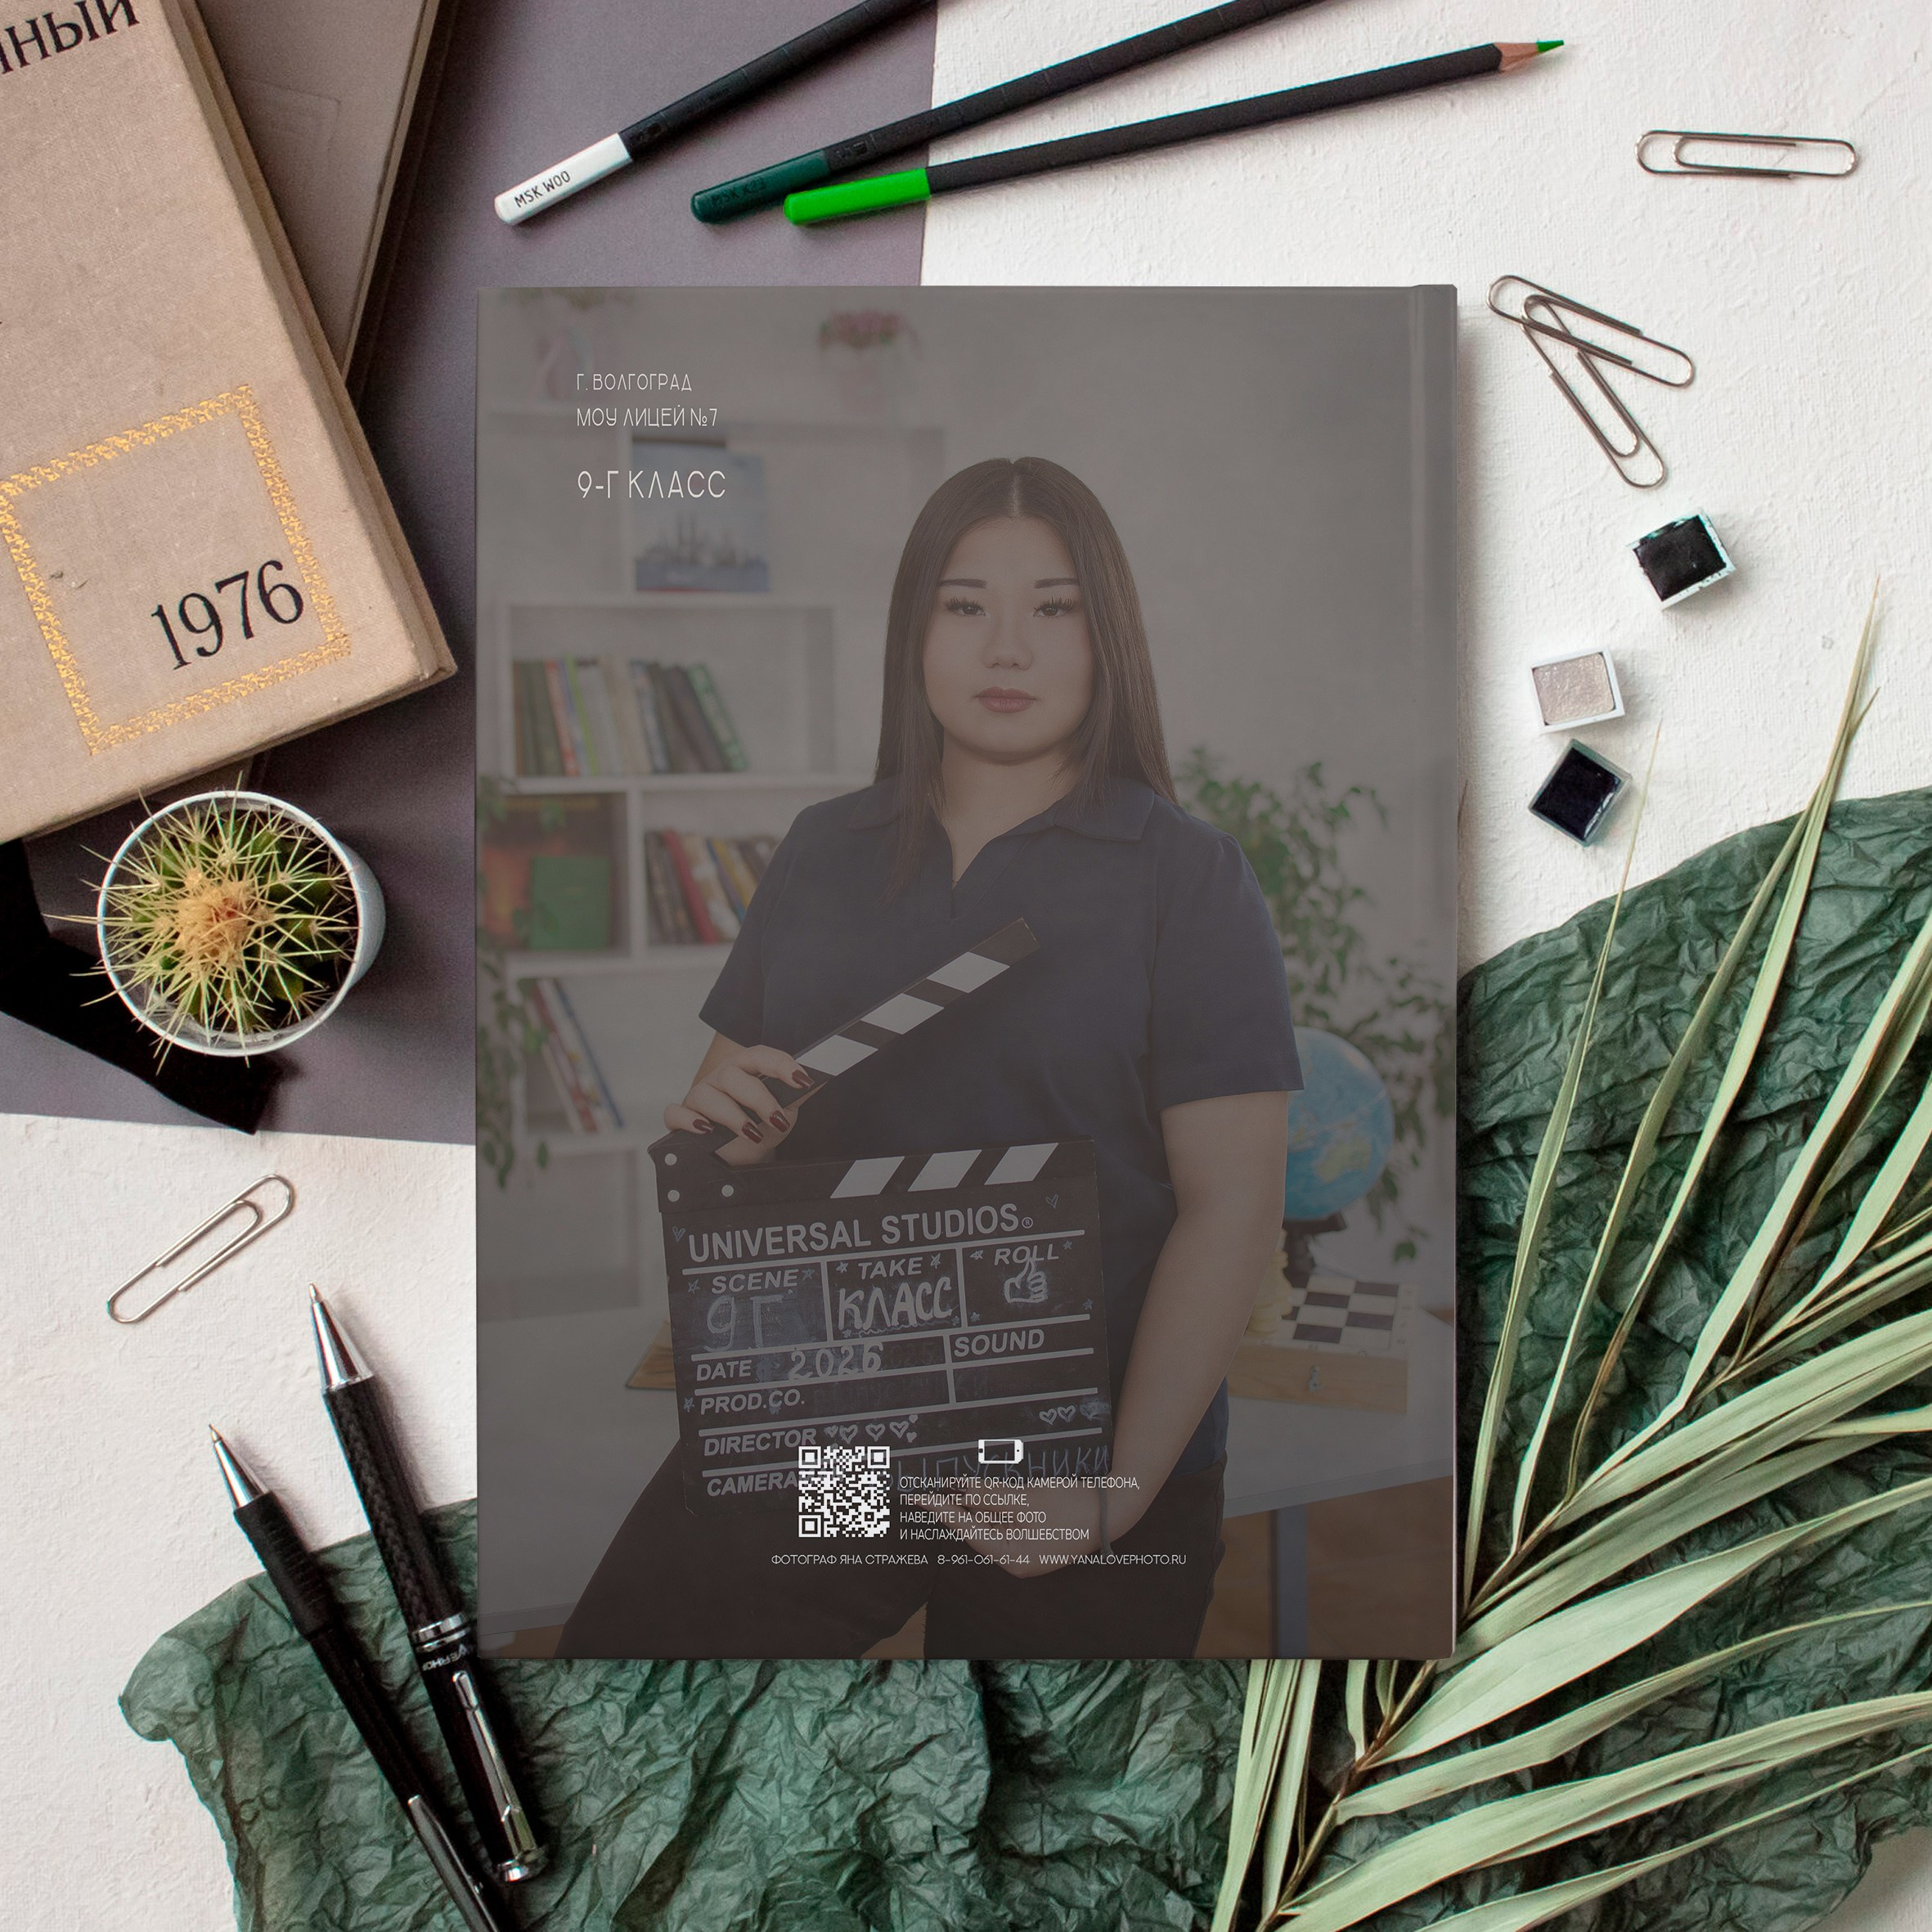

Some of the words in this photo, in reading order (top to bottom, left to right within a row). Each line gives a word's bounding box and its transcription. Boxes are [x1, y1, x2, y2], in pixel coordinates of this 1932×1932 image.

[514, 186, 543, 208] MSK
[577, 373, 588, 391] Г.
[593, 373, 692, 392] ВОЛГОГРАД
[577, 407, 617, 426] МОУ
[623, 404, 685, 428] ЛИЦЕЙ
[577, 470, 619, 499] 9-Г
[629, 470, 726, 499] КЛАСС
[151, 560, 303, 670] 1976
[689, 1219, 871, 1263] UNIVERSAL
[994, 1242, 1060, 1265] ROLL
[859, 1256, 923, 1279] TAKE
[712, 1269, 798, 1294] SCENE
[838, 1277, 952, 1330] КЛАСС
[955, 1329, 1045, 1357] SOUND
[696, 1359, 753, 1382] DATE
[789, 1341, 884, 1380] 2026
[700, 1389, 806, 1414] PROD.CO.
[704, 1427, 817, 1456] DIRECTOR
[869, 1445, 1109, 1492] ЫПУСКНИКИ
[707, 1469, 843, 1497] CAMERA
[900, 1473, 982, 1489] ОТСКАНИРУЙТЕ
[984, 1476, 1025, 1490] QR-КОД
[1027, 1473, 1078, 1489] КАМЕРОЙ
[1081, 1476, 1140, 1490] ТЕЛЕФОНА,
[900, 1490, 962, 1507] ПЕРЕЙДИТЕ
[965, 1494, 982, 1506] ПО
[982, 1494, 1030, 1507] ССЫЛКЕ,
[900, 1511, 955, 1525] НАВЕДИТЕ
[958, 1512, 973, 1523] НА
[975, 1511, 1014, 1525] ОБЩЕЕ
[1016, 1511, 1047, 1523] ФОТО
[900, 1529, 908, 1539] И
[910, 1525, 1004, 1542] НАСЛАЖДАЙТЕСЬ
[1006, 1528, 1090, 1540] ВОЛШЕБСТВОМ
[771, 1554, 837, 1565] ФОТОГРАФ
[840, 1554, 863, 1565] ЯНА
[865, 1554, 928, 1565] СТРАЖЕВА
[937, 1554, 1030, 1565] 8-961-061-61-44
[1039, 1554, 1186, 1565] WWW.YANALOVEPHOTO.RU
